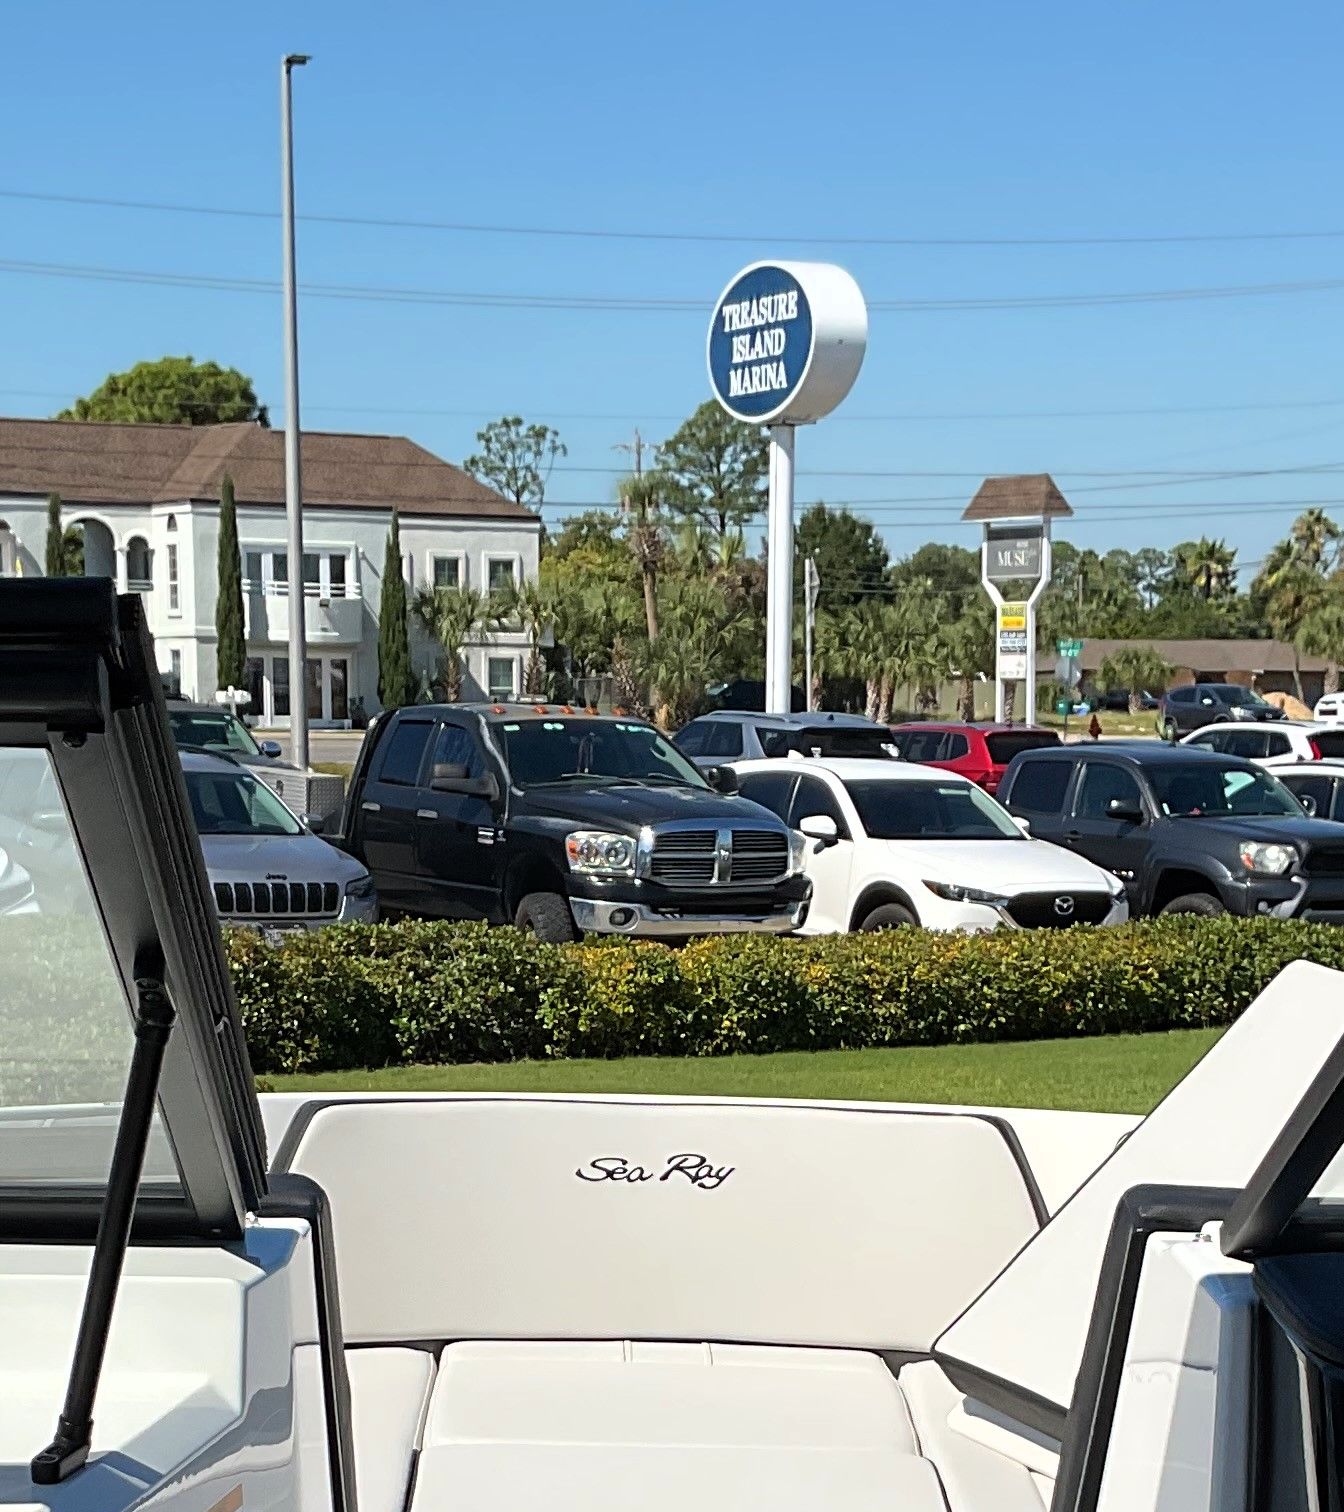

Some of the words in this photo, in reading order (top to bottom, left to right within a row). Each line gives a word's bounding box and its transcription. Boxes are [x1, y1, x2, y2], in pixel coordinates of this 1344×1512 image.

[722, 290, 798, 332] TREASURE
[731, 328, 786, 364] ISLAND
[729, 361, 788, 397] MARINA
[575, 1157, 654, 1182] Sea
[659, 1153, 736, 1190] Ray
